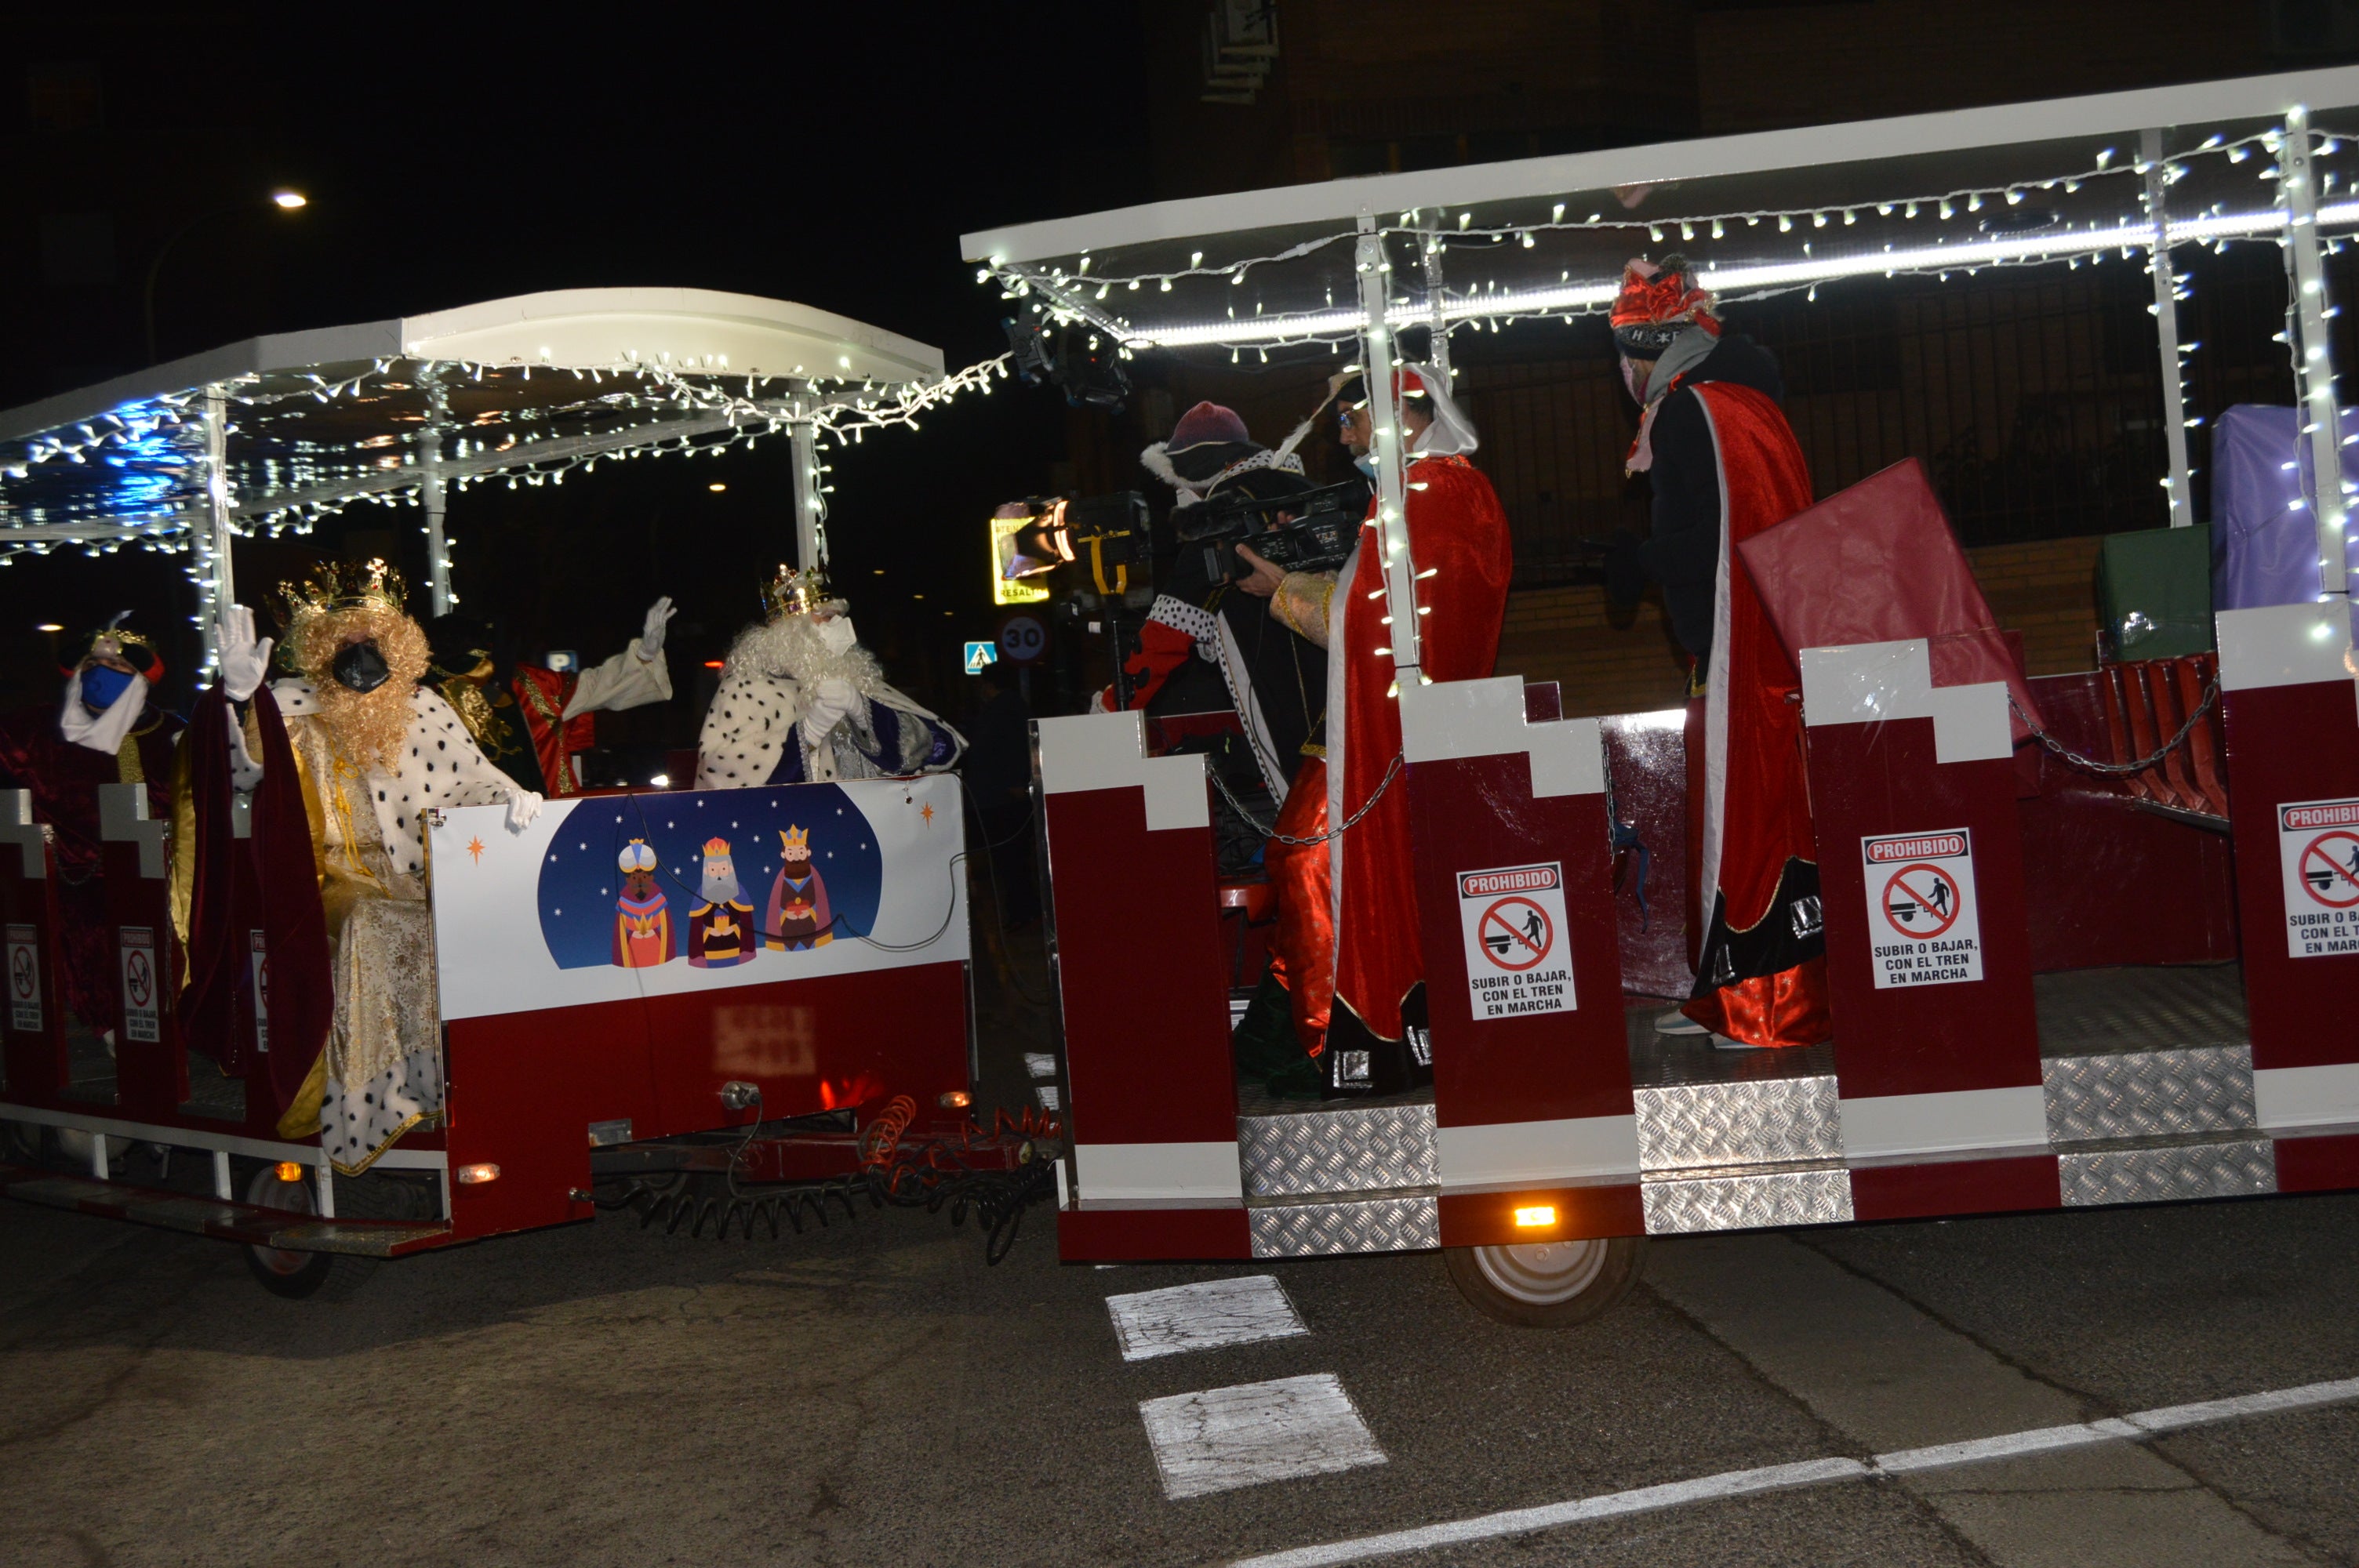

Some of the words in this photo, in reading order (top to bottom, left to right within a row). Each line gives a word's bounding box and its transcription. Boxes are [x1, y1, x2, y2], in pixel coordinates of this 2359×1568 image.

[1001, 588, 1041, 597] RESALT
[1006, 628, 1041, 648] 30
[1873, 837, 1960, 859] PROHIBIDO
[1468, 870, 1552, 893] PROHIBIDO
[2290, 913, 2330, 926] SUBIR
[2335, 912, 2343, 923] O
[2301, 927, 2328, 939] CON
[2333, 926, 2349, 937] EL
[1874, 944, 1914, 957] SUBIR
[1918, 943, 1927, 953] O
[1932, 939, 1978, 953] BAJAR,
[2306, 942, 2322, 953] EN
[2327, 940, 2359, 952] MAR
[1885, 958, 1912, 971] CON
[1917, 956, 1932, 967] EL
[1936, 953, 1969, 966] TREN
[1472, 976, 1510, 989] SUBIR
[1514, 975, 1522, 985] O
[1526, 971, 1572, 984] BAJAR,
[1890, 972, 1906, 984] EN
[1911, 967, 1968, 982] MARCHA
[1482, 989, 1509, 1002] CON
[1513, 988, 1528, 999] EL
[1531, 984, 1563, 997] TREN
[1487, 1004, 1503, 1015] EN
[1507, 998, 1562, 1014] MARCHA
